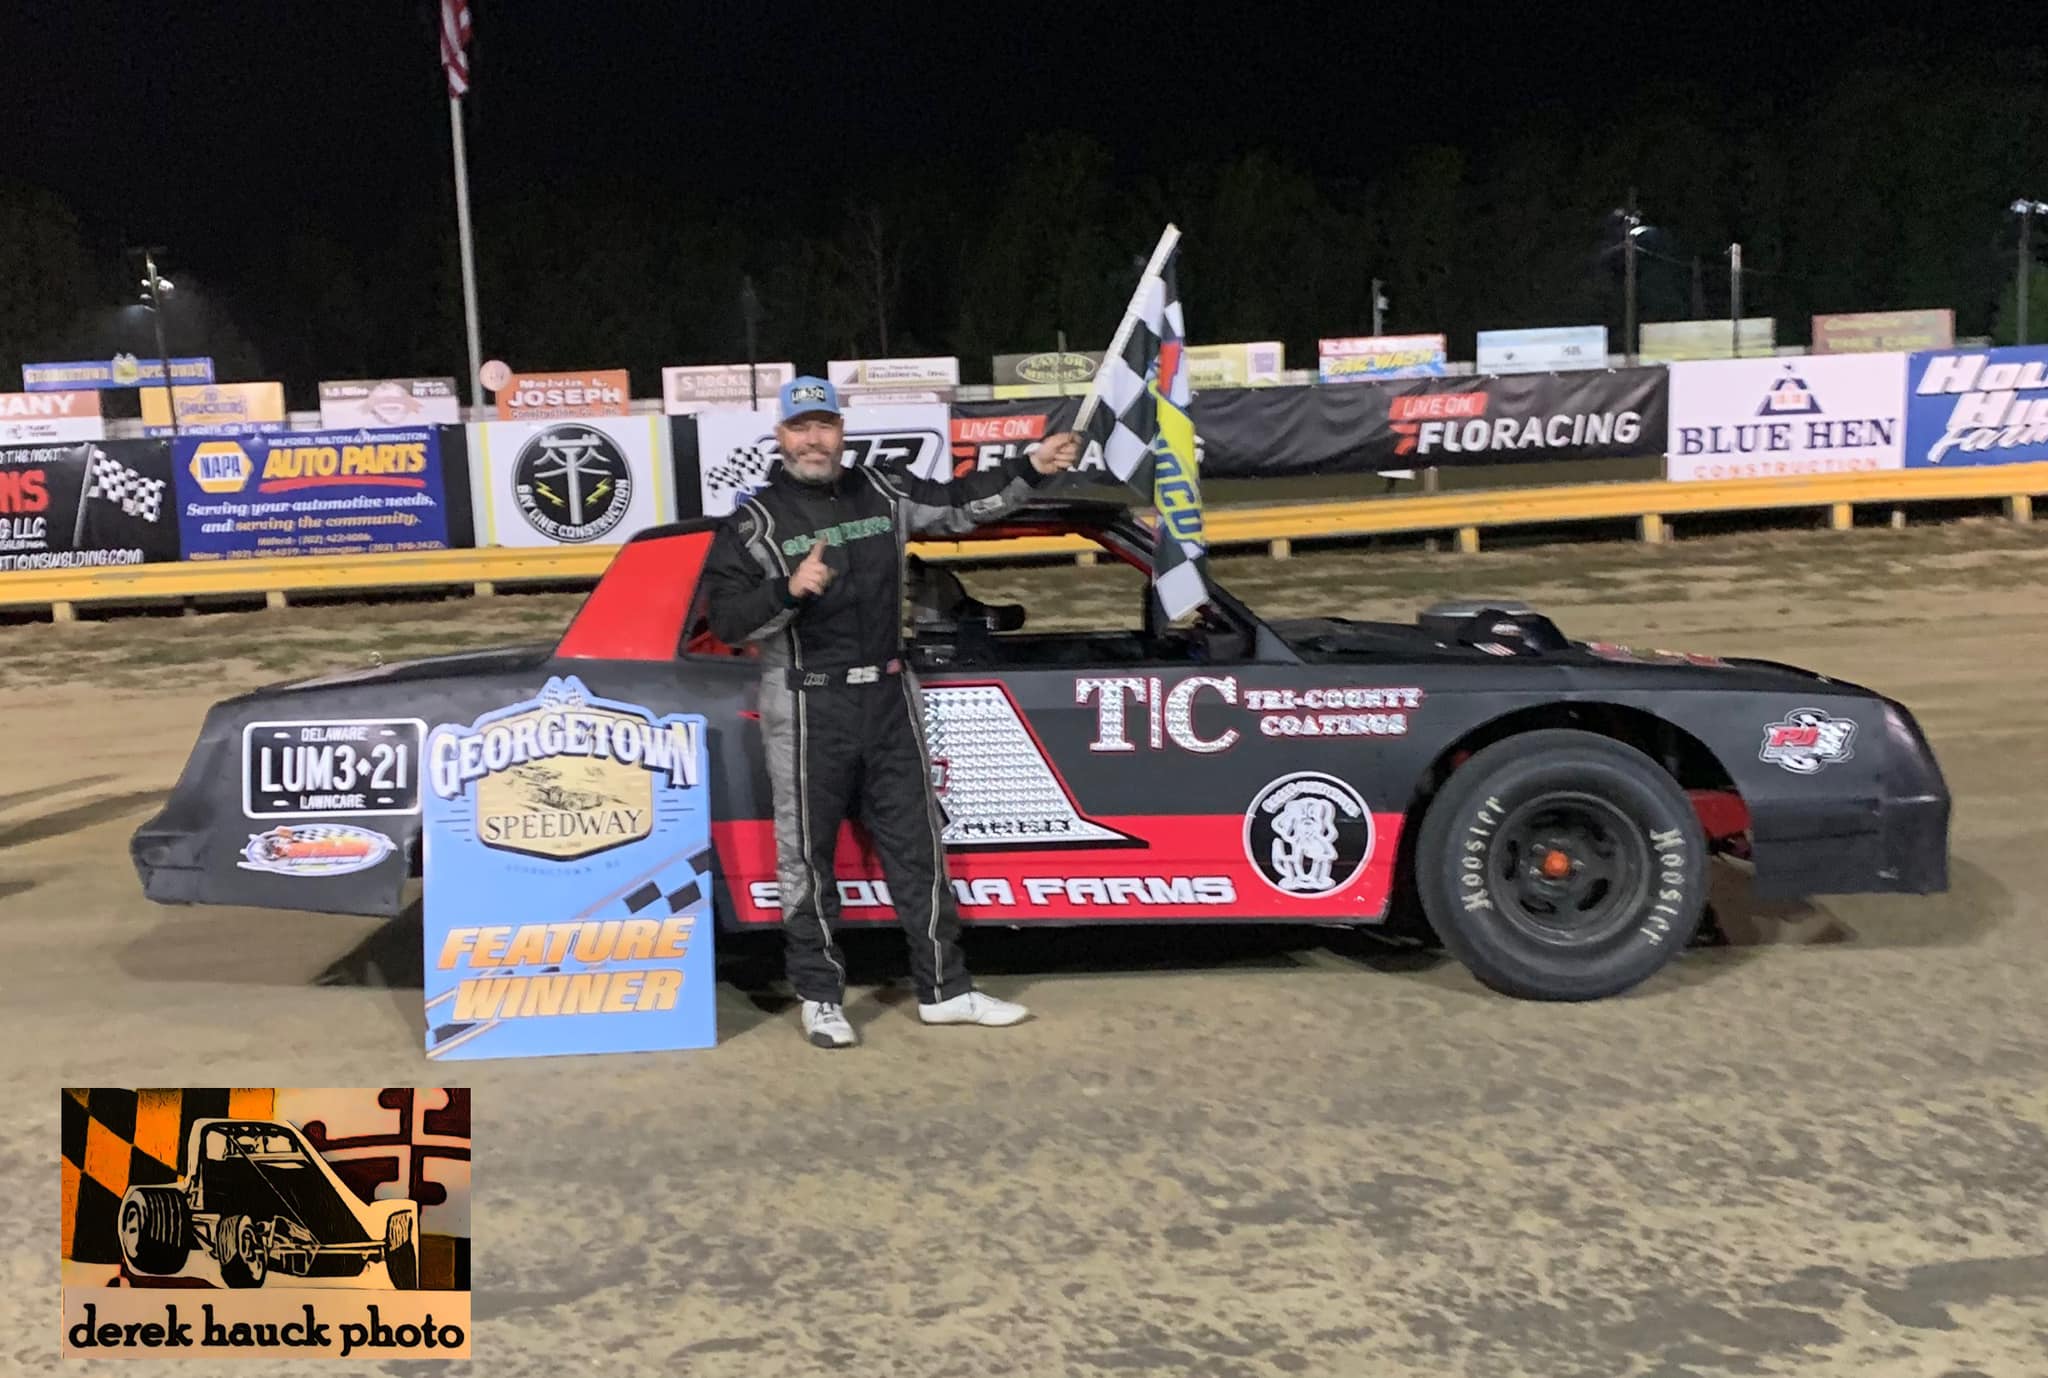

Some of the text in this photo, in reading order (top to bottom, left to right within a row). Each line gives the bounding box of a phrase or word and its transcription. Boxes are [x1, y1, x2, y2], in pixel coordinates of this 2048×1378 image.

[507, 387, 622, 408] JOSEPH
[1402, 393, 1473, 418] LIVE ON
[959, 418, 1033, 440] LIVE ON
[1417, 410, 1641, 455] FLORACING
[1677, 417, 1897, 456] BLUE HEN
[200, 454, 243, 478] NAPA
[262, 442, 427, 478] AUTO PARTS
[1693, 456, 1879, 480] CONSTRUCTION
[187, 501, 249, 517] Serving
[251, 501, 290, 516] your
[291, 495, 383, 512] automotive
[516, 478, 630, 539] BAY LINE CONSTRUCTION
[13, 516, 47, 539] LLC
[201, 519, 234, 533] and
[235, 516, 294, 533] serving
[298, 514, 322, 529] the
[1244, 687, 1423, 710] TRI-COUNTY
[301, 727, 369, 743] DELAWARE
[1260, 713, 1408, 736] COATINGS
[428, 711, 699, 800] GEORGETOWN
[300, 793, 367, 810] LAWNCARE
[484, 808, 645, 842] SPEEDWAY
[1022, 877, 1239, 905] FARMS
[436, 916, 696, 971] FEATURE
[452, 969, 685, 1022] WINNER
